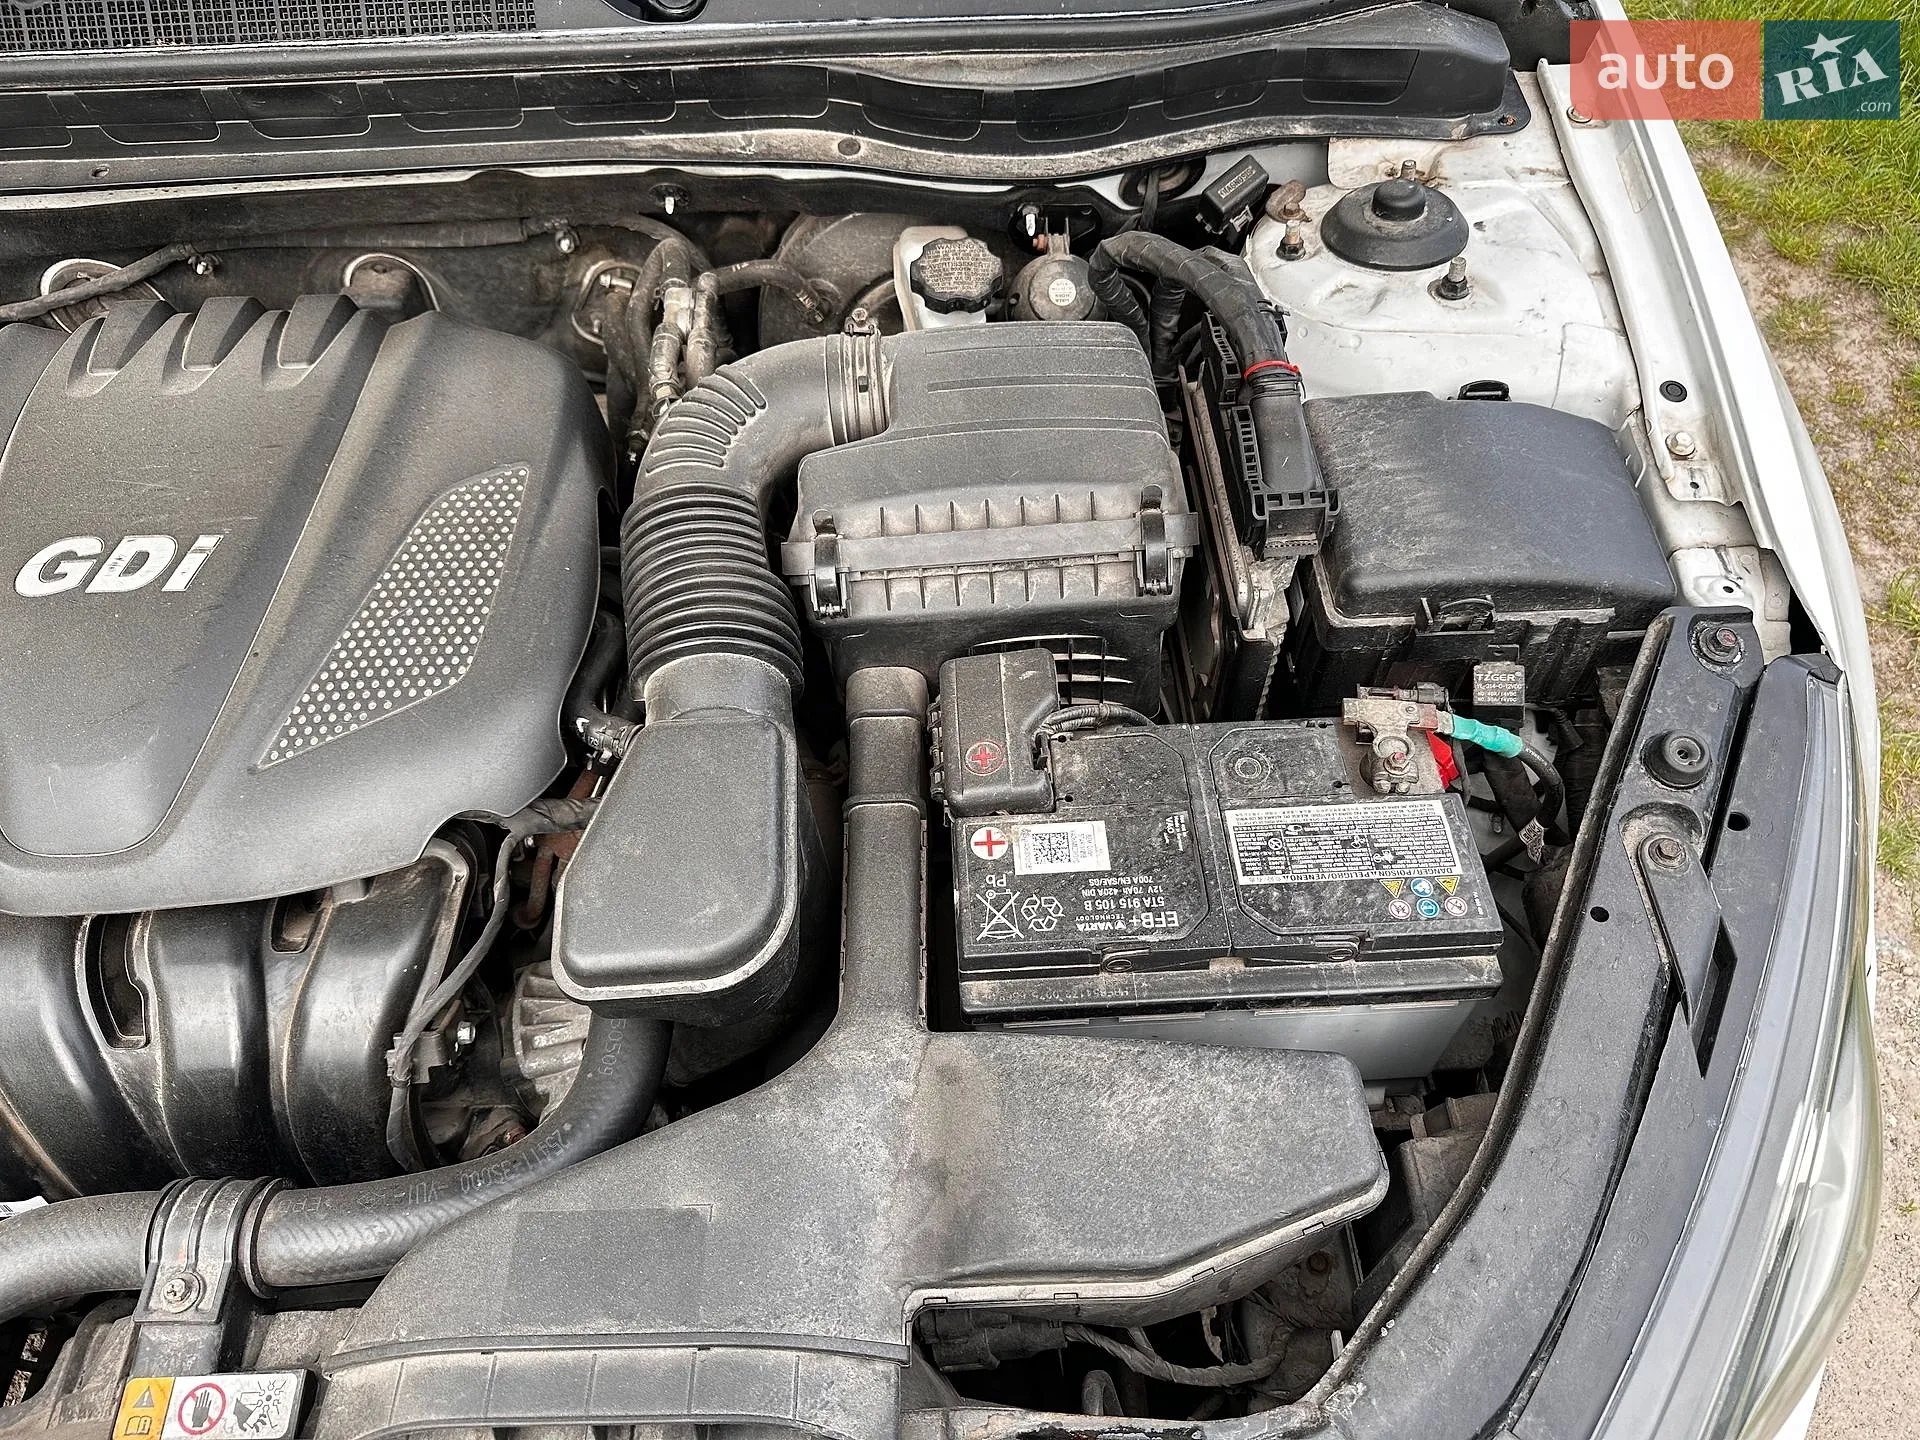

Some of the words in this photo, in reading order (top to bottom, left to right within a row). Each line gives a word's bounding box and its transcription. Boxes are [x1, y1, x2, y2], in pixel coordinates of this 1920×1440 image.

[15, 533, 224, 598] GDi
[985, 873, 1007, 888] Pb
[1132, 876, 1154, 884] 700A
[1081, 888, 1096, 897] DIN
[1097, 887, 1118, 896] 420A
[1123, 886, 1143, 895] 70Ah
[1147, 885, 1164, 893] 12V
[1083, 900, 1092, 911] B
[1095, 898, 1116, 910] 105
[1120, 897, 1141, 909] 915
[1142, 896, 1164, 908] 5TA
[1128, 910, 1180, 928] EFB+
[1075, 921, 1114, 931] VARTA
